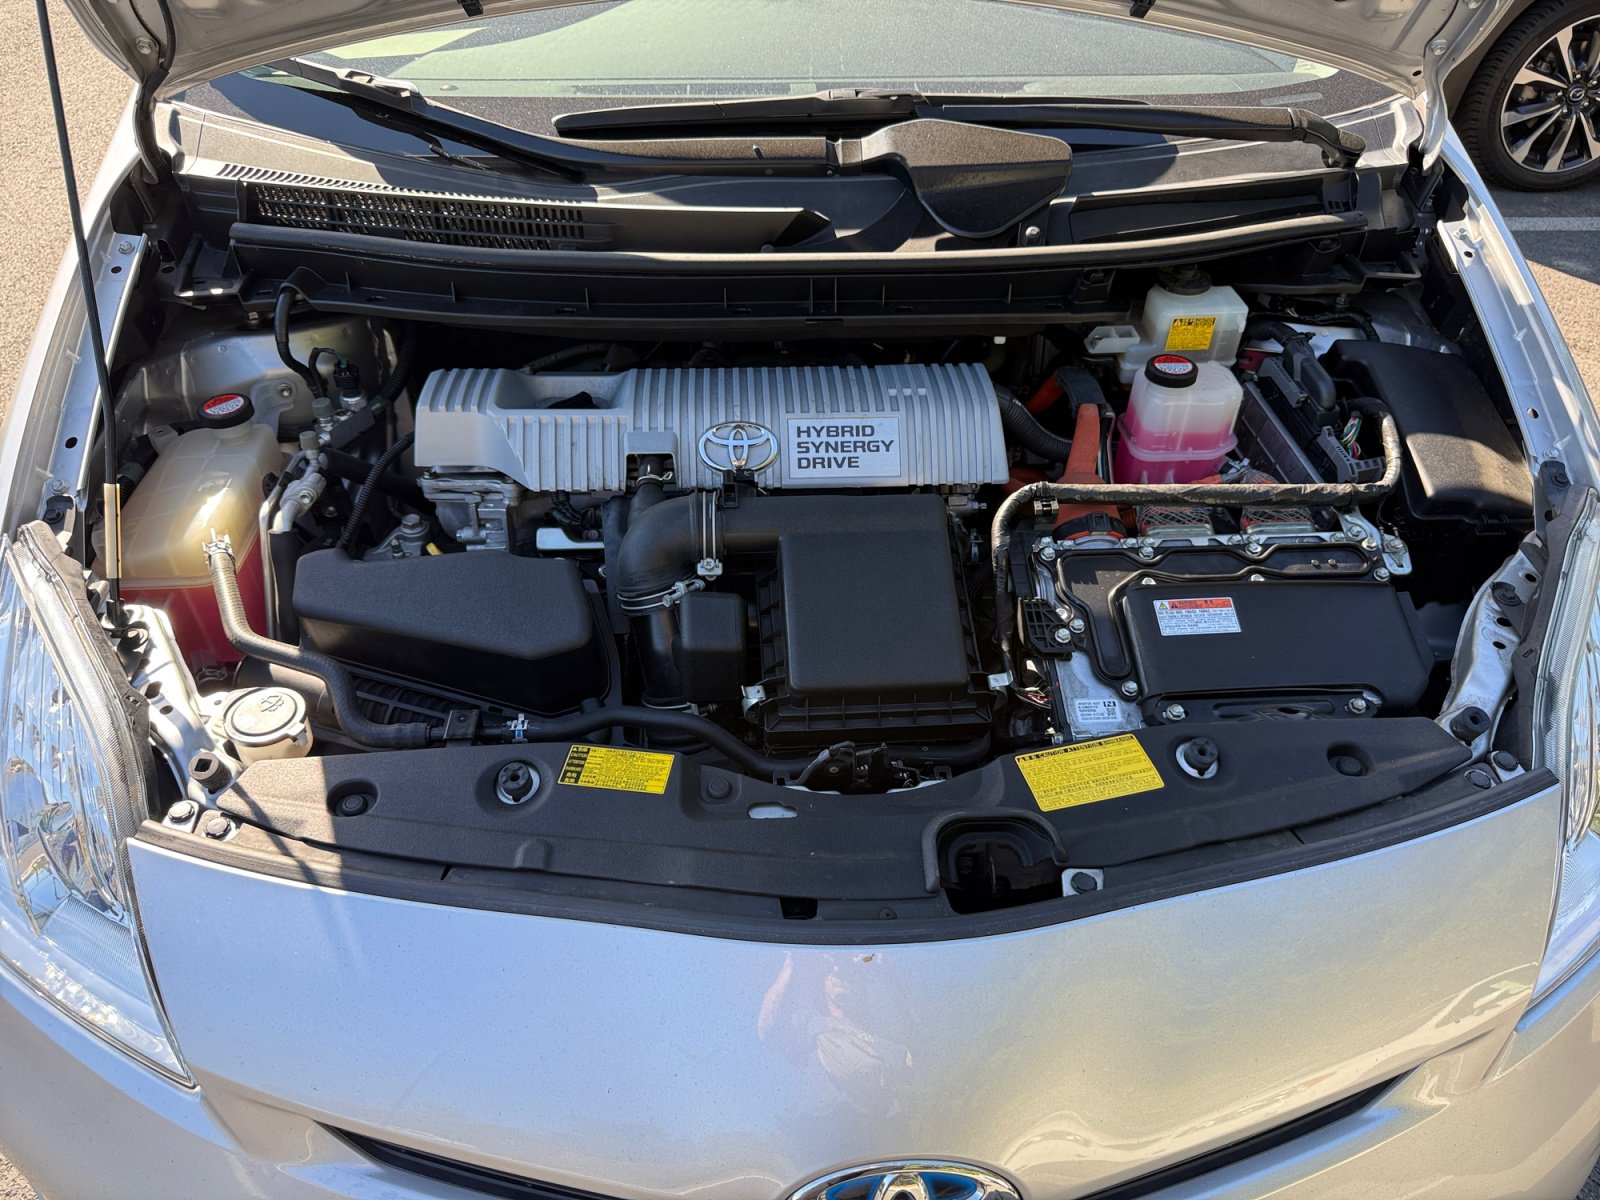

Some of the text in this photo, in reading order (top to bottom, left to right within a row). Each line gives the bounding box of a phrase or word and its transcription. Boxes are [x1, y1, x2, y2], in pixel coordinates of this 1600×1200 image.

[797, 425, 875, 438] HYBRID
[797, 440, 894, 453] SYNERGY
[797, 456, 860, 469] DRIVE
[1040, 749, 1065, 758] CAUTION
[1067, 742, 1100, 752] ATTENTION
